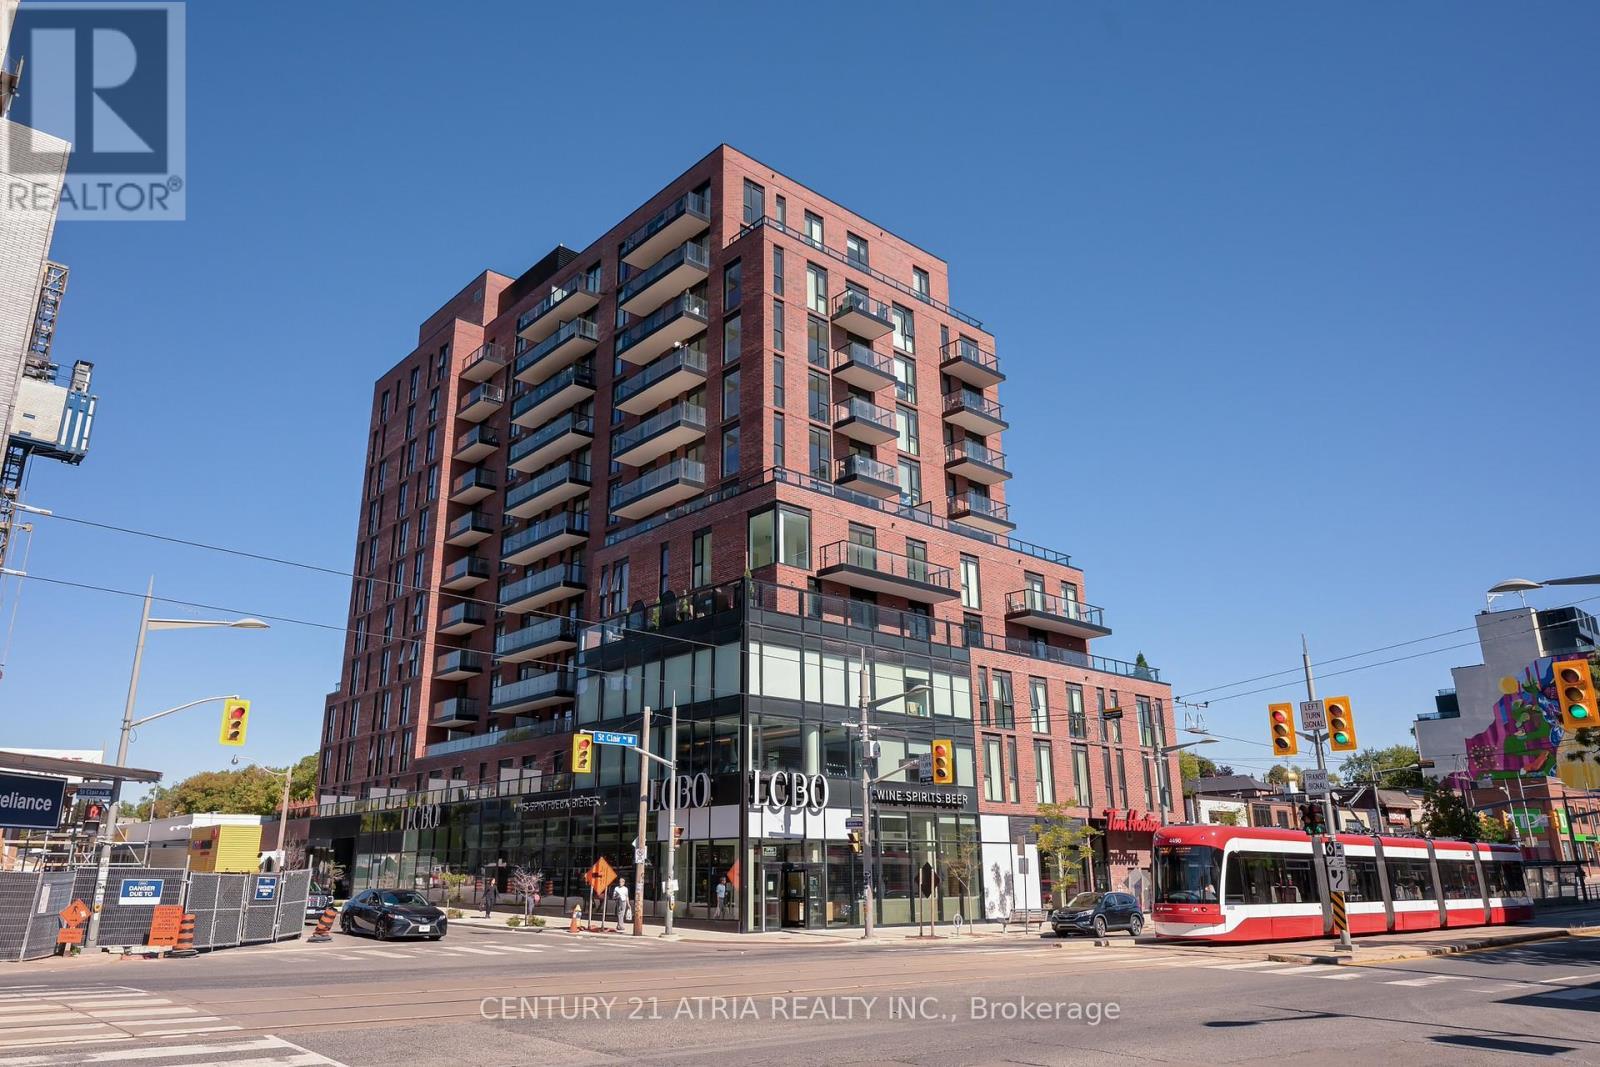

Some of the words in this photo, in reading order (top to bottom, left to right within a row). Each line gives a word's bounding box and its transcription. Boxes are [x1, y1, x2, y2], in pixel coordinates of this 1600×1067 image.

[1303, 720, 1325, 729] SIGNAL
[606, 734, 621, 743] Clair
[1306, 772, 1326, 780] TRANSIT
[649, 772, 711, 812] LCBO
[754, 769, 830, 809] LCBO
[877, 789, 902, 801] WINE
[905, 791, 942, 803] SPIRITS
[945, 793, 968, 805] BEER
[0, 792, 53, 811] eliance
[407, 804, 440, 830] LCBO
[1104, 809, 1127, 831] Tim
[1127, 809, 1162, 832] Horton
